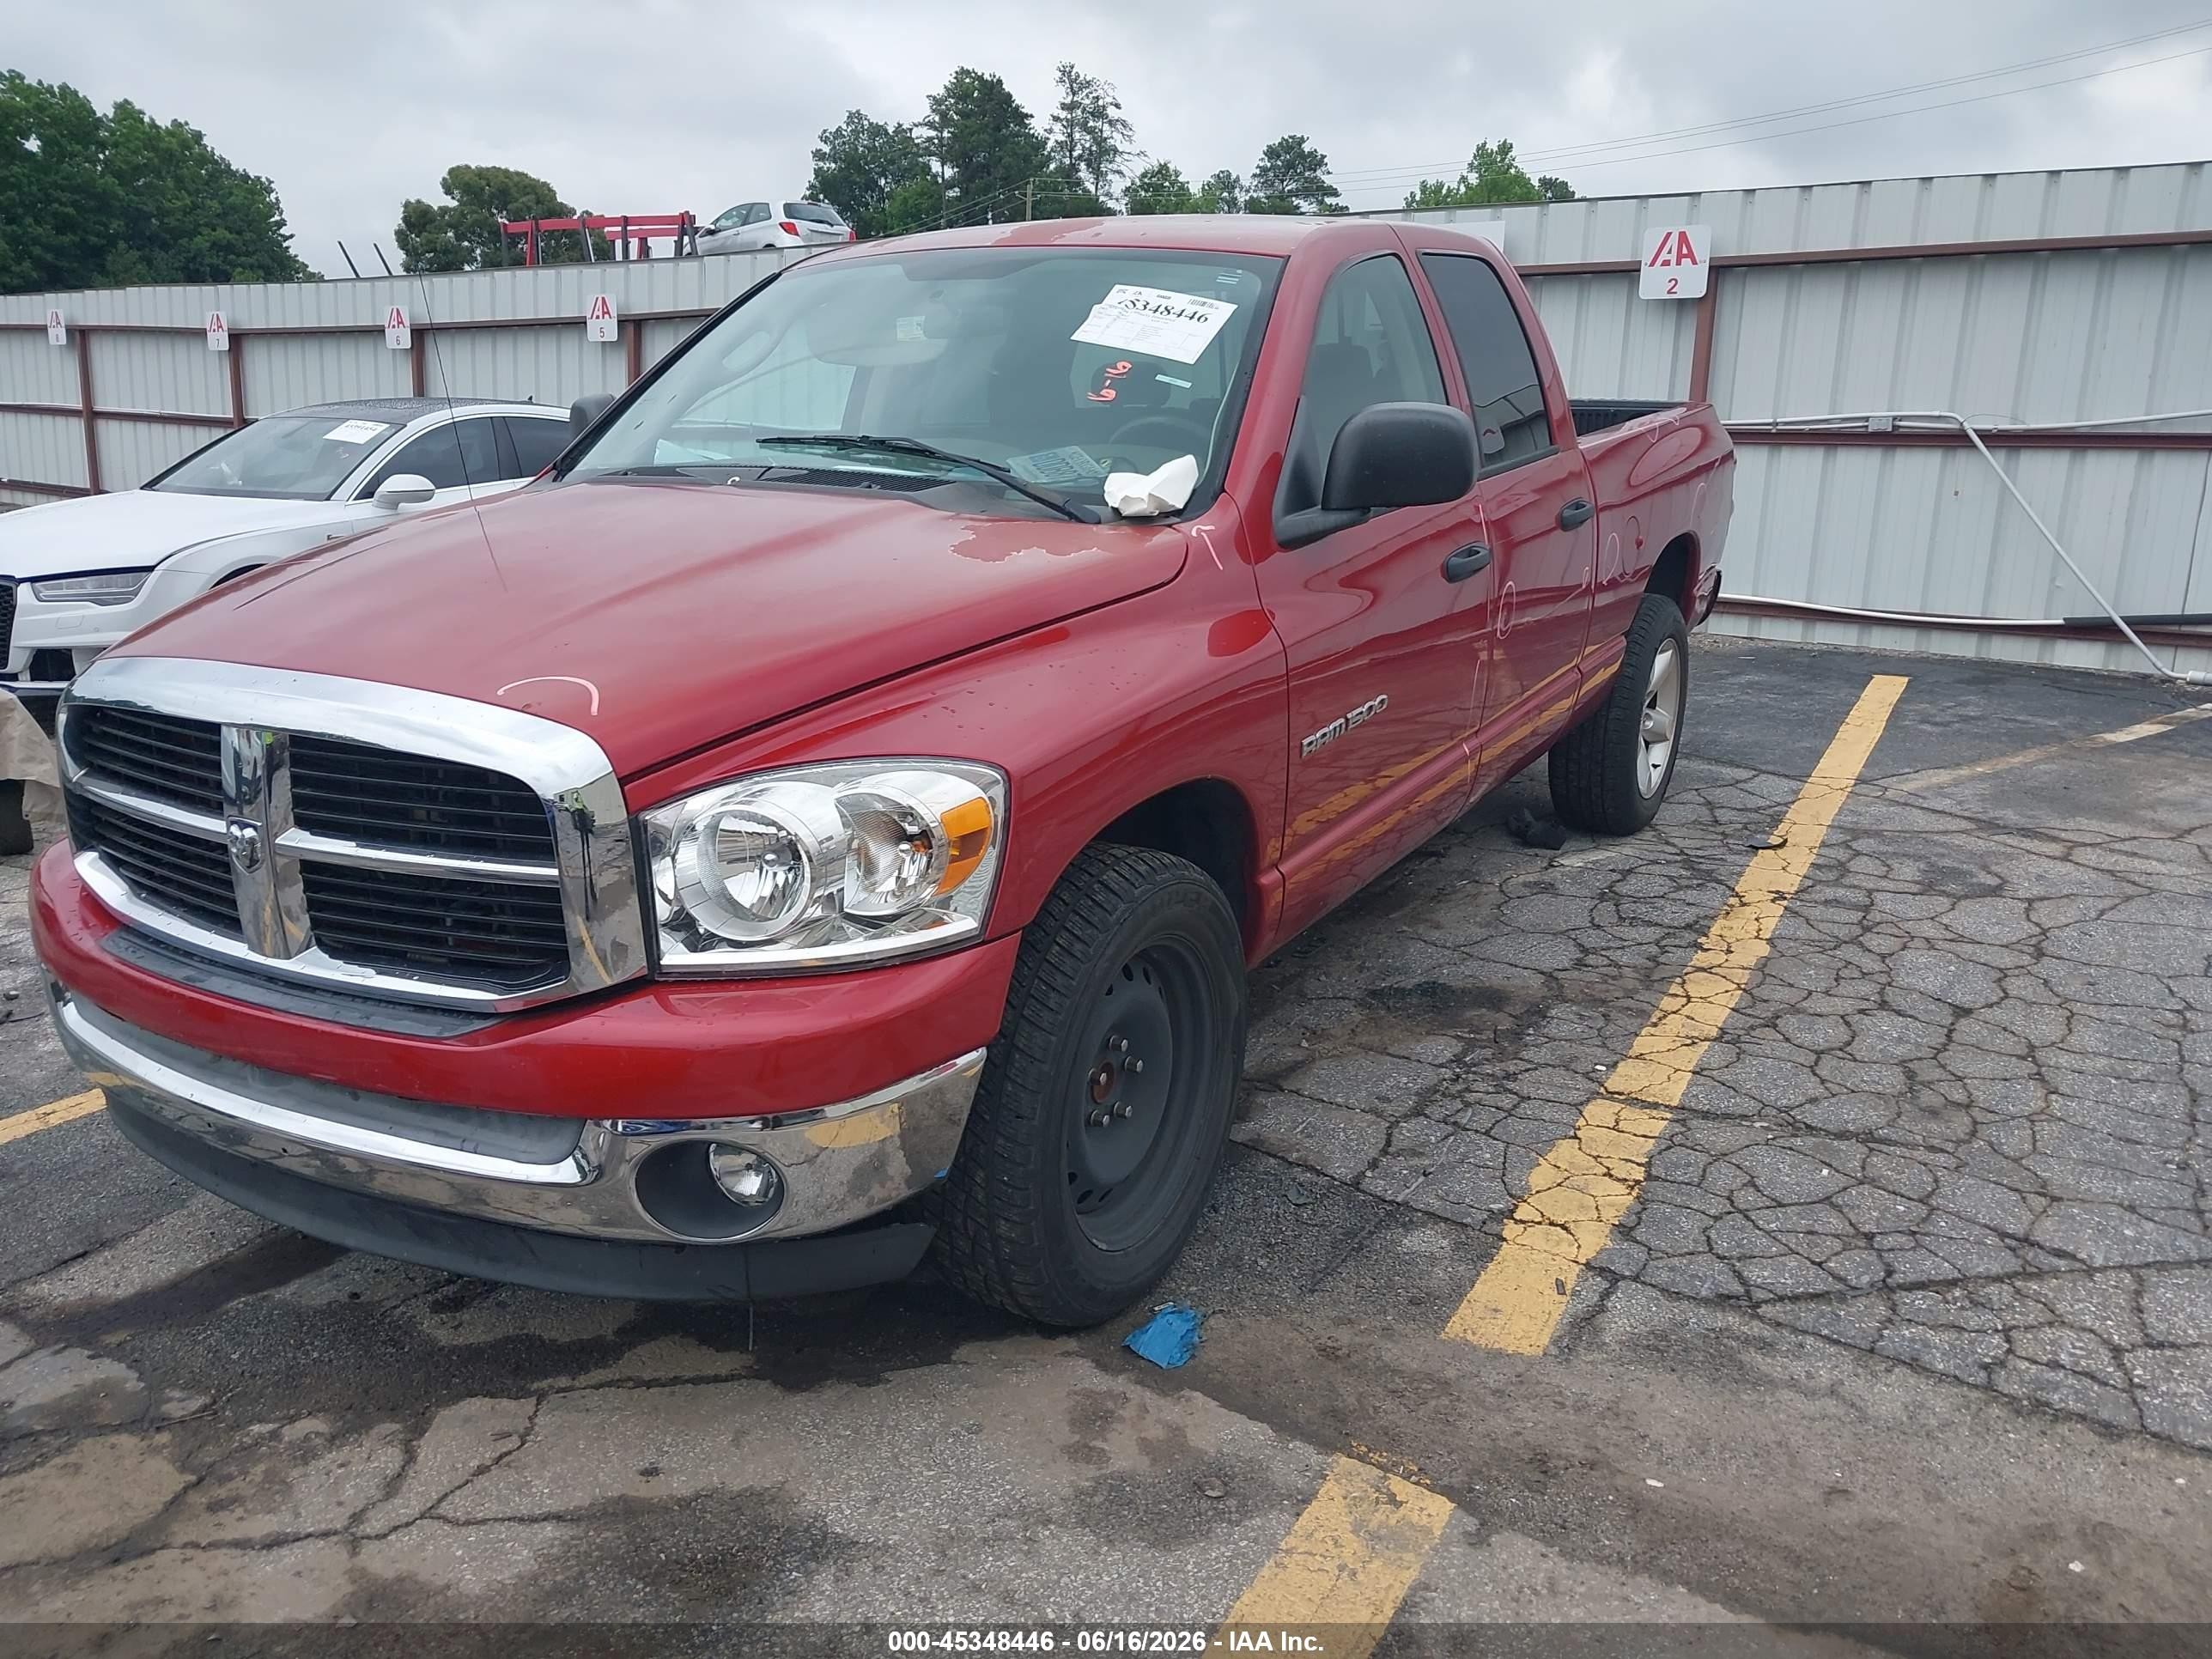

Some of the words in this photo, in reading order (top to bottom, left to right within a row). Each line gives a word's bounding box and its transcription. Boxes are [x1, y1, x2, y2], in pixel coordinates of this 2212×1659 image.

[1666, 277, 1679, 295] 2
[599, 326, 605, 338] 5
[216, 338, 220, 349] 7
[395, 335, 401, 346] 6
[1300, 717, 1346, 759] RAM
[1346, 694, 1389, 730] 1500
